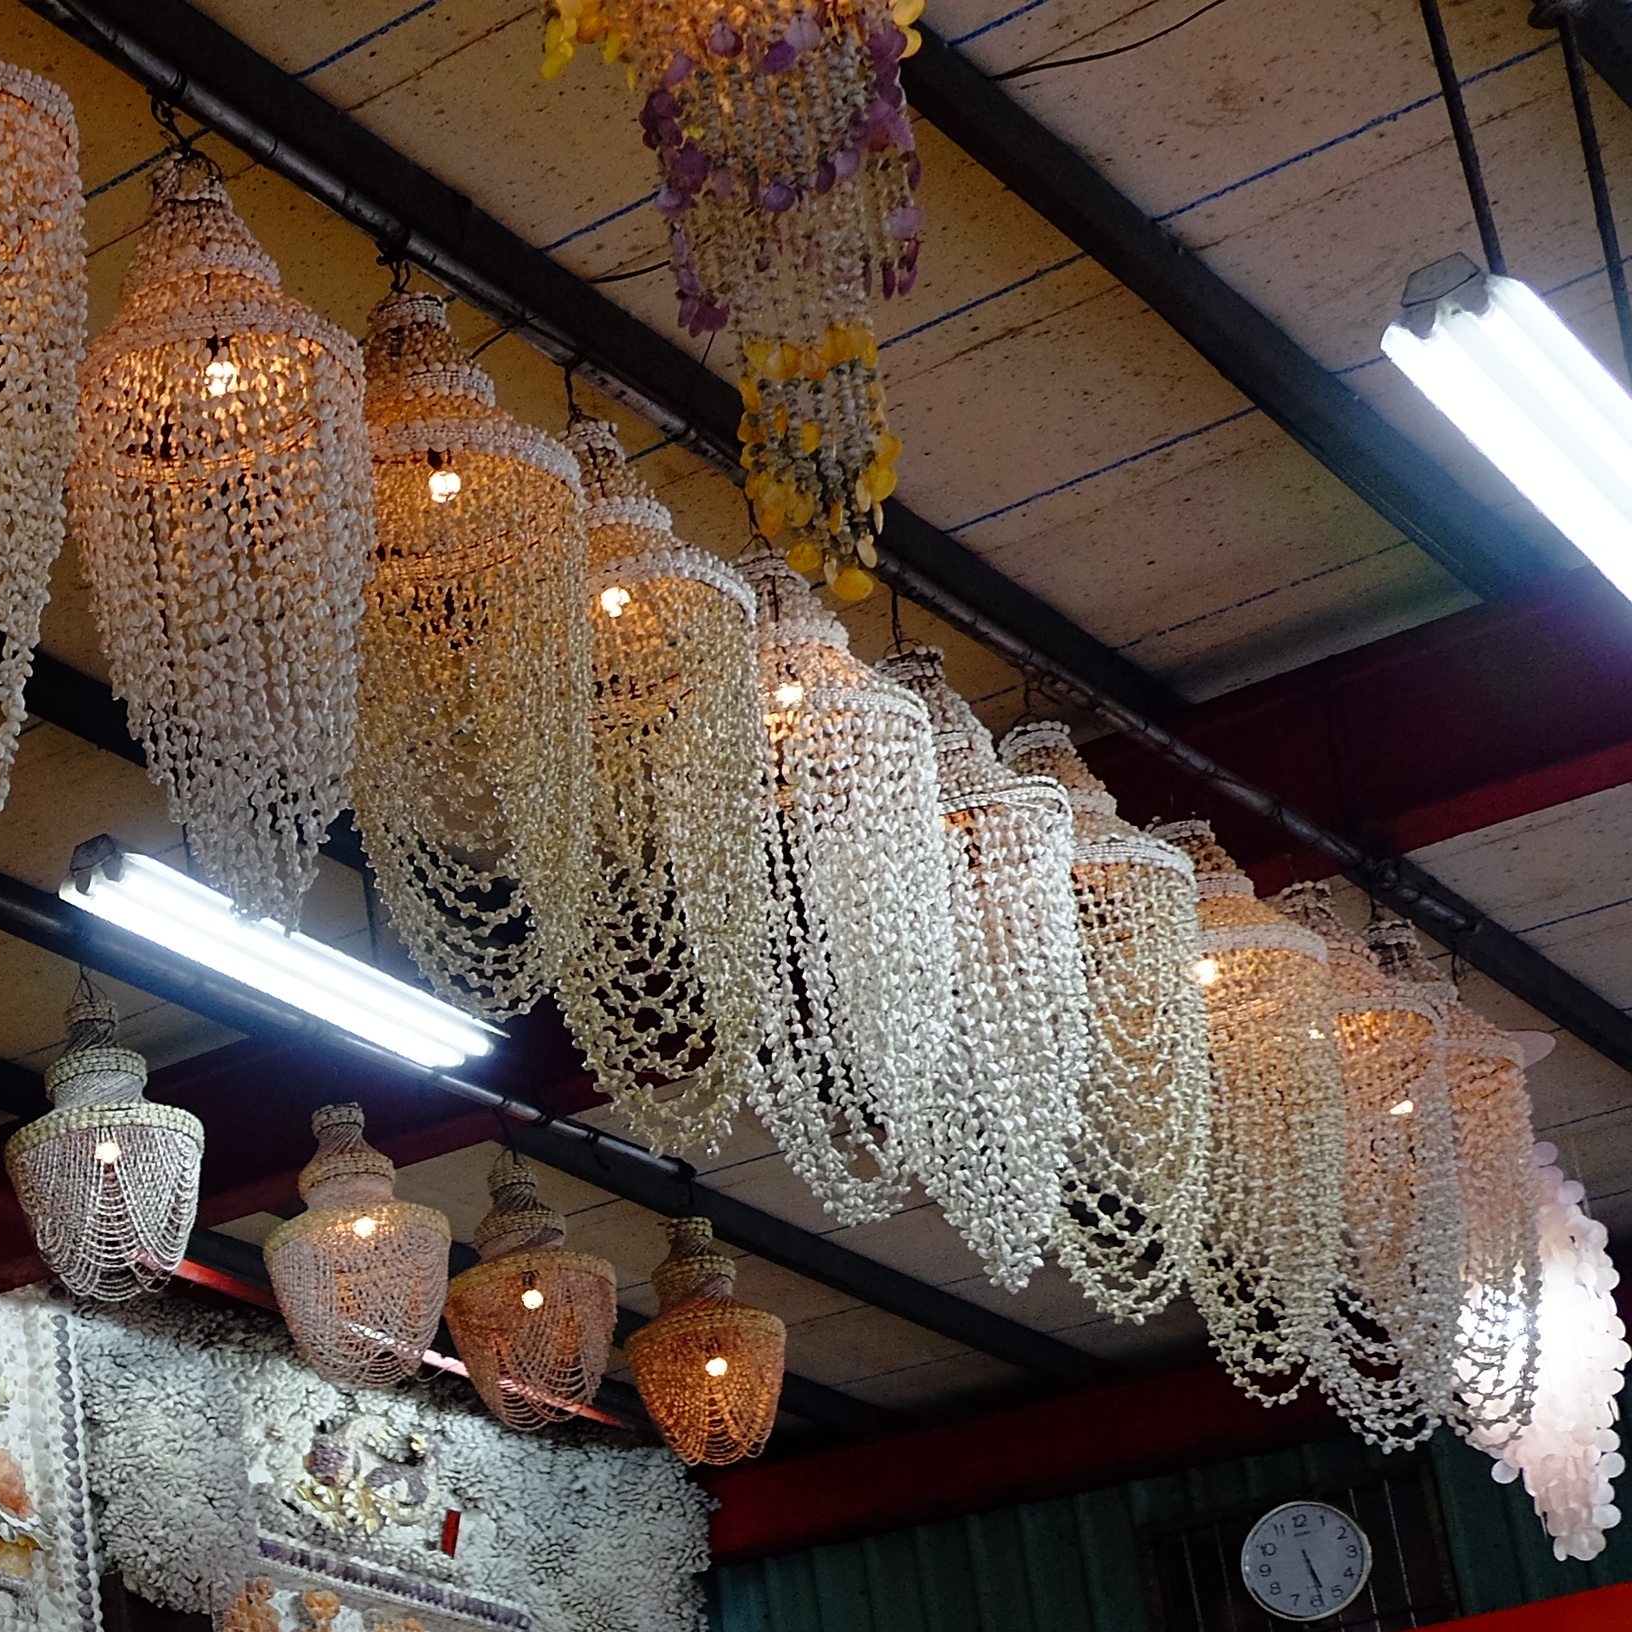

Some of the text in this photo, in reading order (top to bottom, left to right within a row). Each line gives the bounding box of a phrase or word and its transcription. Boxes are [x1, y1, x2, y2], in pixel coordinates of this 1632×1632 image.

[1292, 1513, 1307, 1528] 12
[1320, 1515, 1325, 1527] 1
[1273, 1524, 1286, 1536] 11
[1336, 1526, 1347, 1540] 2
[1260, 1543, 1277, 1557] 10
[1346, 1545, 1358, 1558] 3
[1259, 1564, 1271, 1577] 9
[1343, 1567, 1355, 1579] 4
[1269, 1581, 1281, 1595] 8
[1331, 1585, 1343, 1598] 5
[1290, 1593, 1300, 1607] 7
